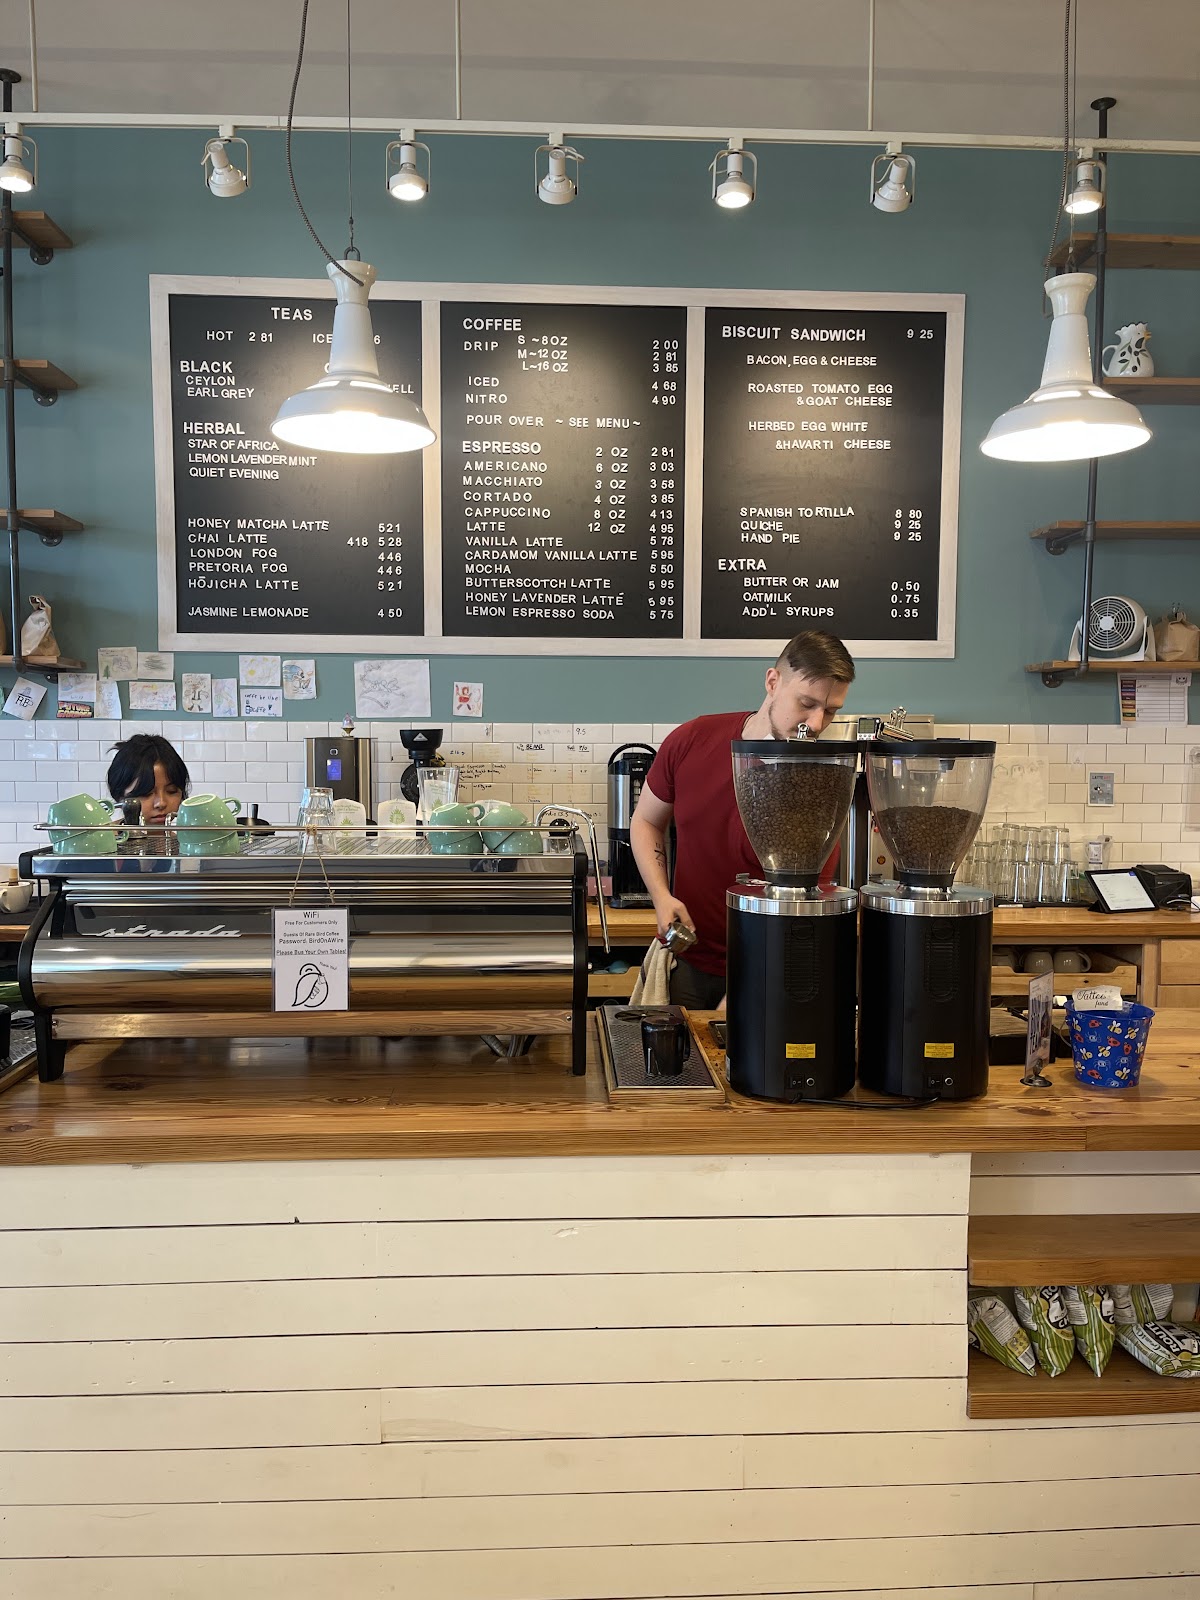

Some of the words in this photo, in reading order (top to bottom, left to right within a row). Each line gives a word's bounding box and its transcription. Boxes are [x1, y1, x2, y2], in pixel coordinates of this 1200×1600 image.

[271, 307, 312, 321] TEAS
[463, 318, 521, 331] COFFEE
[207, 331, 233, 341] HOT
[312, 333, 333, 343] ICE
[722, 326, 781, 339] BISCUIT
[791, 328, 865, 341] SANDWICH
[464, 341, 498, 351] DRIP
[518, 335, 525, 344] S
[550, 336, 568, 346] OZ
[551, 350, 567, 360] OZ
[180, 360, 232, 373] BLACK
[793, 356, 817, 365] EGG
[820, 356, 828, 365] &
[831, 356, 877, 366] CHEESE
[552, 363, 568, 372] OZ
[186, 375, 235, 386] CEYLON
[469, 376, 499, 387] ICED
[187, 387, 219, 397] EARL
[221, 388, 254, 399] GREY
[748, 383, 804, 393] ROASTED
[811, 384, 860, 394] TOMATO
[868, 384, 893, 394] EGG
[466, 394, 507, 404] NITRO
[845, 396, 892, 406] CHEESE
[467, 415, 502, 424] POUR
[509, 416, 544, 426] OVER
[569, 417, 589, 427] SEE
[596, 418, 629, 428] MENU
[749, 421, 795, 431] HERBED
[801, 421, 826, 431] EGG
[831, 422, 868, 432] WHITE
[184, 422, 245, 434] HERBAL
[188, 439, 217, 449] STAR
[220, 440, 235, 450] OF
[237, 440, 280, 451] AFRICA
[463, 441, 541, 454] ESPRESSO
[596, 447, 602, 456] 2
[611, 447, 628, 457] OZ
[844, 439, 891, 449] CHEESE
[189, 453, 228, 463] LEMON
[231, 454, 288, 464] LAVENDER
[289, 456, 317, 466] MINT
[464, 461, 547, 472] AMERICANO
[596, 463, 603, 472] 6
[611, 463, 628, 472] OZ
[189, 467, 225, 477] QUIET
[229, 468, 279, 480] EVENING
[463, 476, 542, 486] MACCHIATO
[595, 480, 602, 489] 3
[610, 479, 626, 489] OZ
[464, 491, 532, 502] CORTADO
[594, 495, 601, 504] 4
[609, 495, 626, 505] OZ
[465, 507, 550, 518] CAPPUCCINO
[594, 509, 601, 519] 8
[609, 509, 626, 519] OZ
[740, 507, 792, 517] SPANISH
[188, 518, 231, 529] HONEY
[237, 519, 287, 529] MATCHA
[292, 520, 329, 531] LATTE
[467, 522, 505, 531] LATTE
[588, 522, 600, 532] 12
[610, 524, 625, 534] OZ
[741, 521, 783, 531] QUICHE
[188, 533, 219, 543] CHAI
[229, 533, 267, 543] LATTE
[465, 536, 517, 546] VANILLA
[526, 537, 563, 546] LATTE
[741, 533, 773, 543] HAND
[782, 533, 800, 543] PIE
[191, 548, 242, 558] LONDON
[252, 548, 277, 558] FOG
[465, 550, 538, 560] CARDAMOM
[544, 550, 595, 560] VANILLA
[599, 551, 637, 560] LATTE
[189, 562, 253, 573] PRETORIA
[262, 563, 287, 572] FOG
[465, 564, 511, 574] MOCHA
[718, 559, 767, 571] EXTRA
[256, 579, 299, 590] LATTE
[466, 577, 566, 588] BUTTERSCOTCH
[571, 578, 610, 589] LATTE
[744, 577, 787, 587] BUTTER
[792, 577, 808, 587] OR
[816, 579, 839, 588] JAM
[891, 581, 920, 591] 0.50
[466, 592, 507, 602] HONEY
[513, 593, 576, 603] LAVENDER
[743, 592, 791, 602] OATMILK
[891, 594, 920, 603] 0.75
[188, 607, 237, 617] JASMINE
[243, 607, 309, 617] LEMONADE
[466, 606, 505, 616] LEMON
[513, 608, 575, 618] ESPRESSO
[583, 609, 614, 619] SODA
[742, 604, 777, 617] ADD'L
[786, 607, 834, 616] SYRUPS
[891, 609, 918, 618] 0.35
[96, 924, 242, 938] strada
[1144, 1322, 1180, 1352] ROUTE
